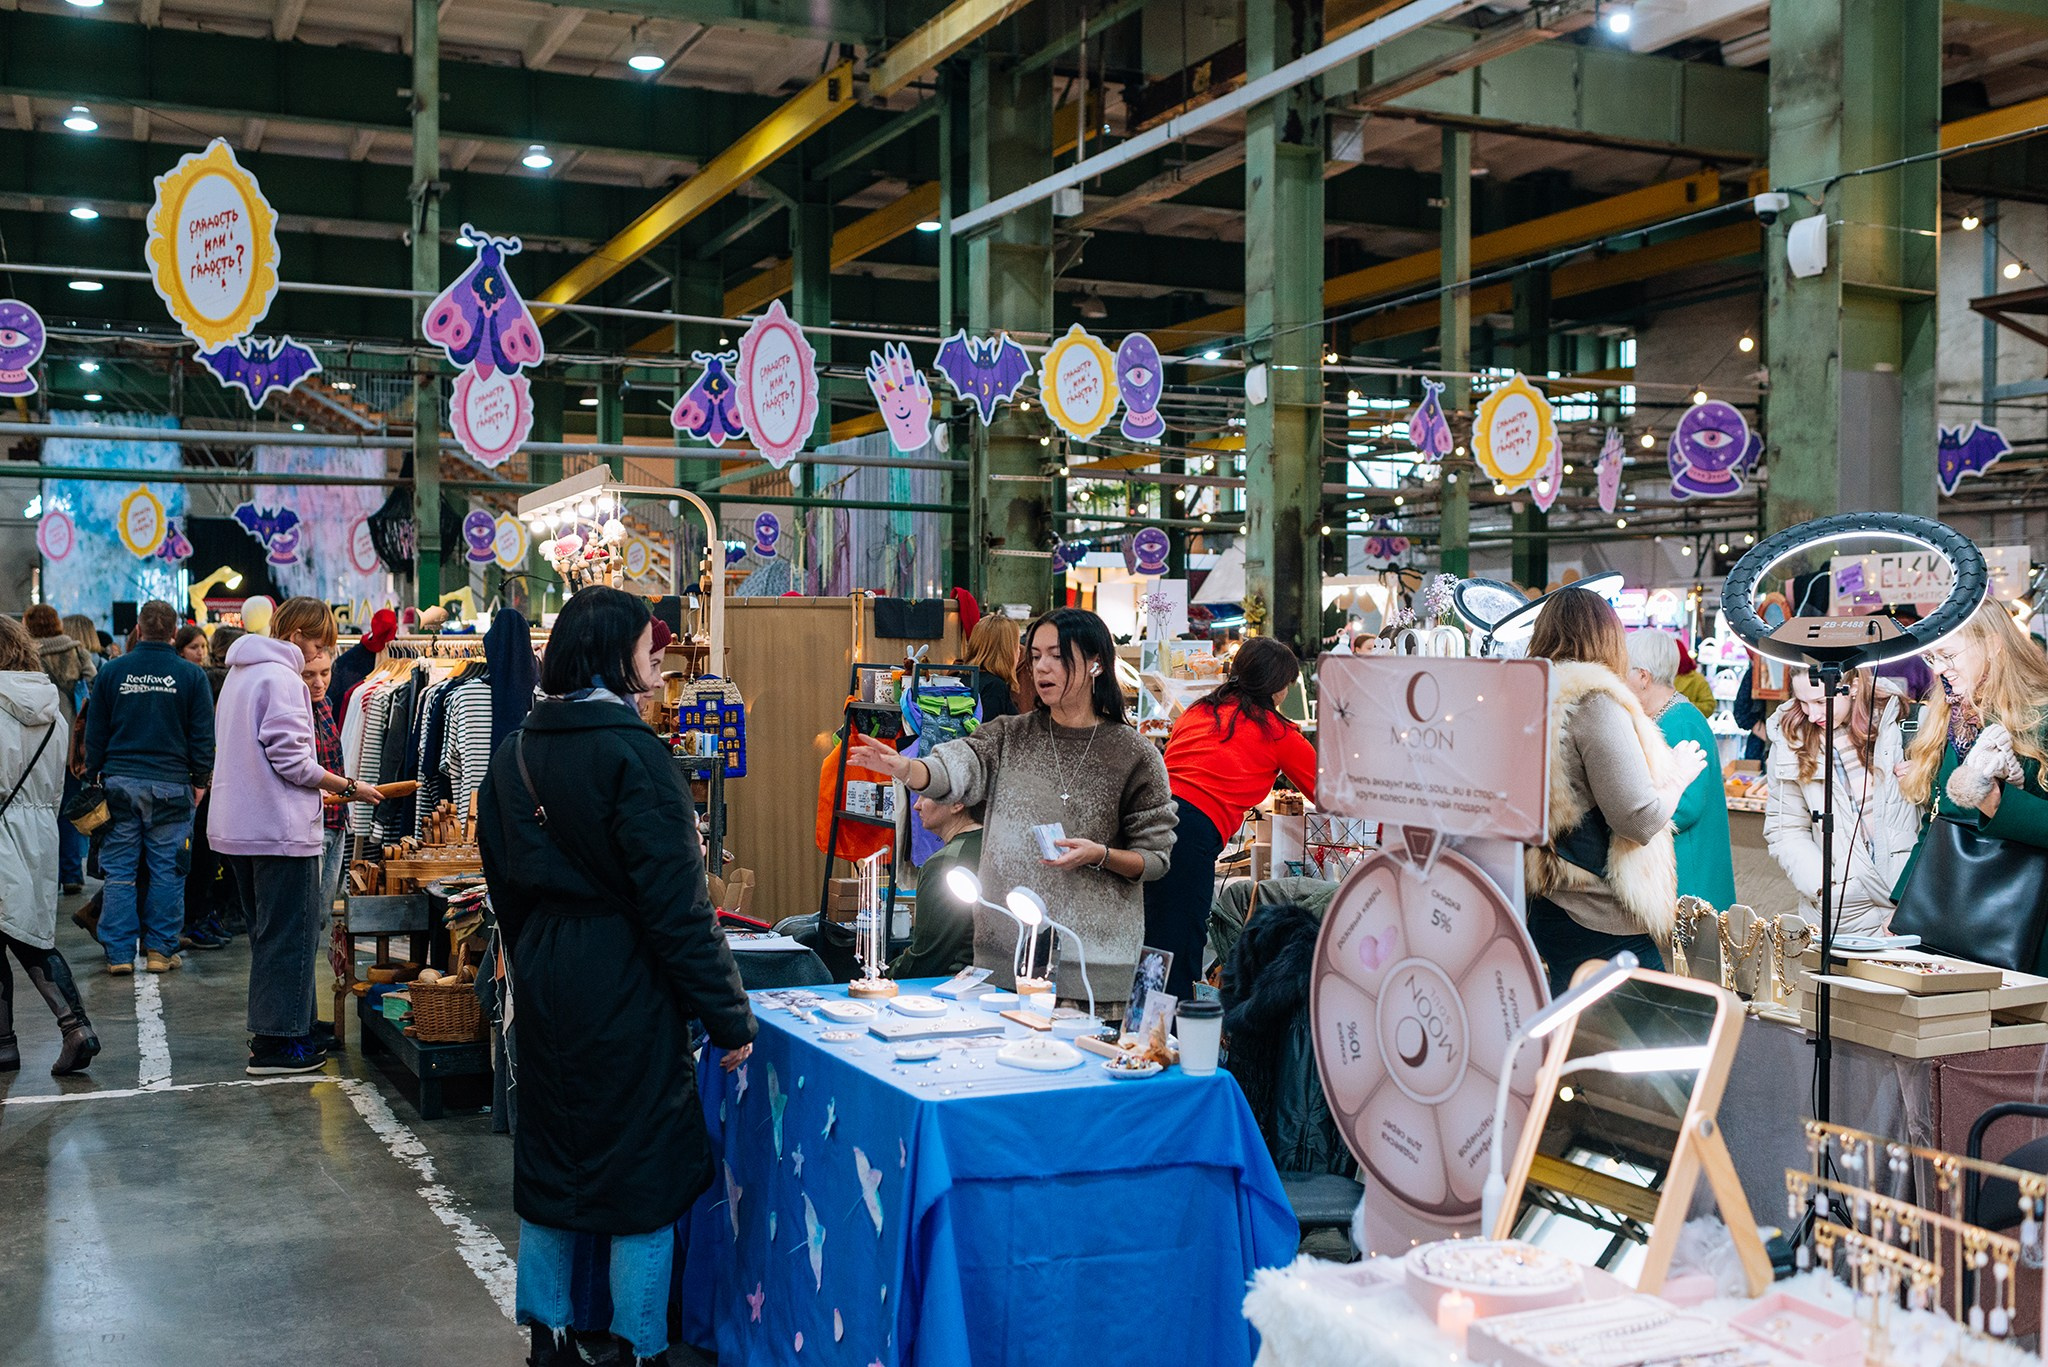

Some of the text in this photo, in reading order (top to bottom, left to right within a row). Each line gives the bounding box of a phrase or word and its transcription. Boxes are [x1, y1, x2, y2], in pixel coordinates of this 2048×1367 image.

[204, 232, 226, 257] ИЛИ
[1823, 621, 1864, 629] ZB-F488
[1391, 726, 1454, 750] MOON
[1416, 797, 1452, 809] поучай
[1431, 908, 1452, 933] 5%
[1347, 1021, 1361, 1062] 10%
